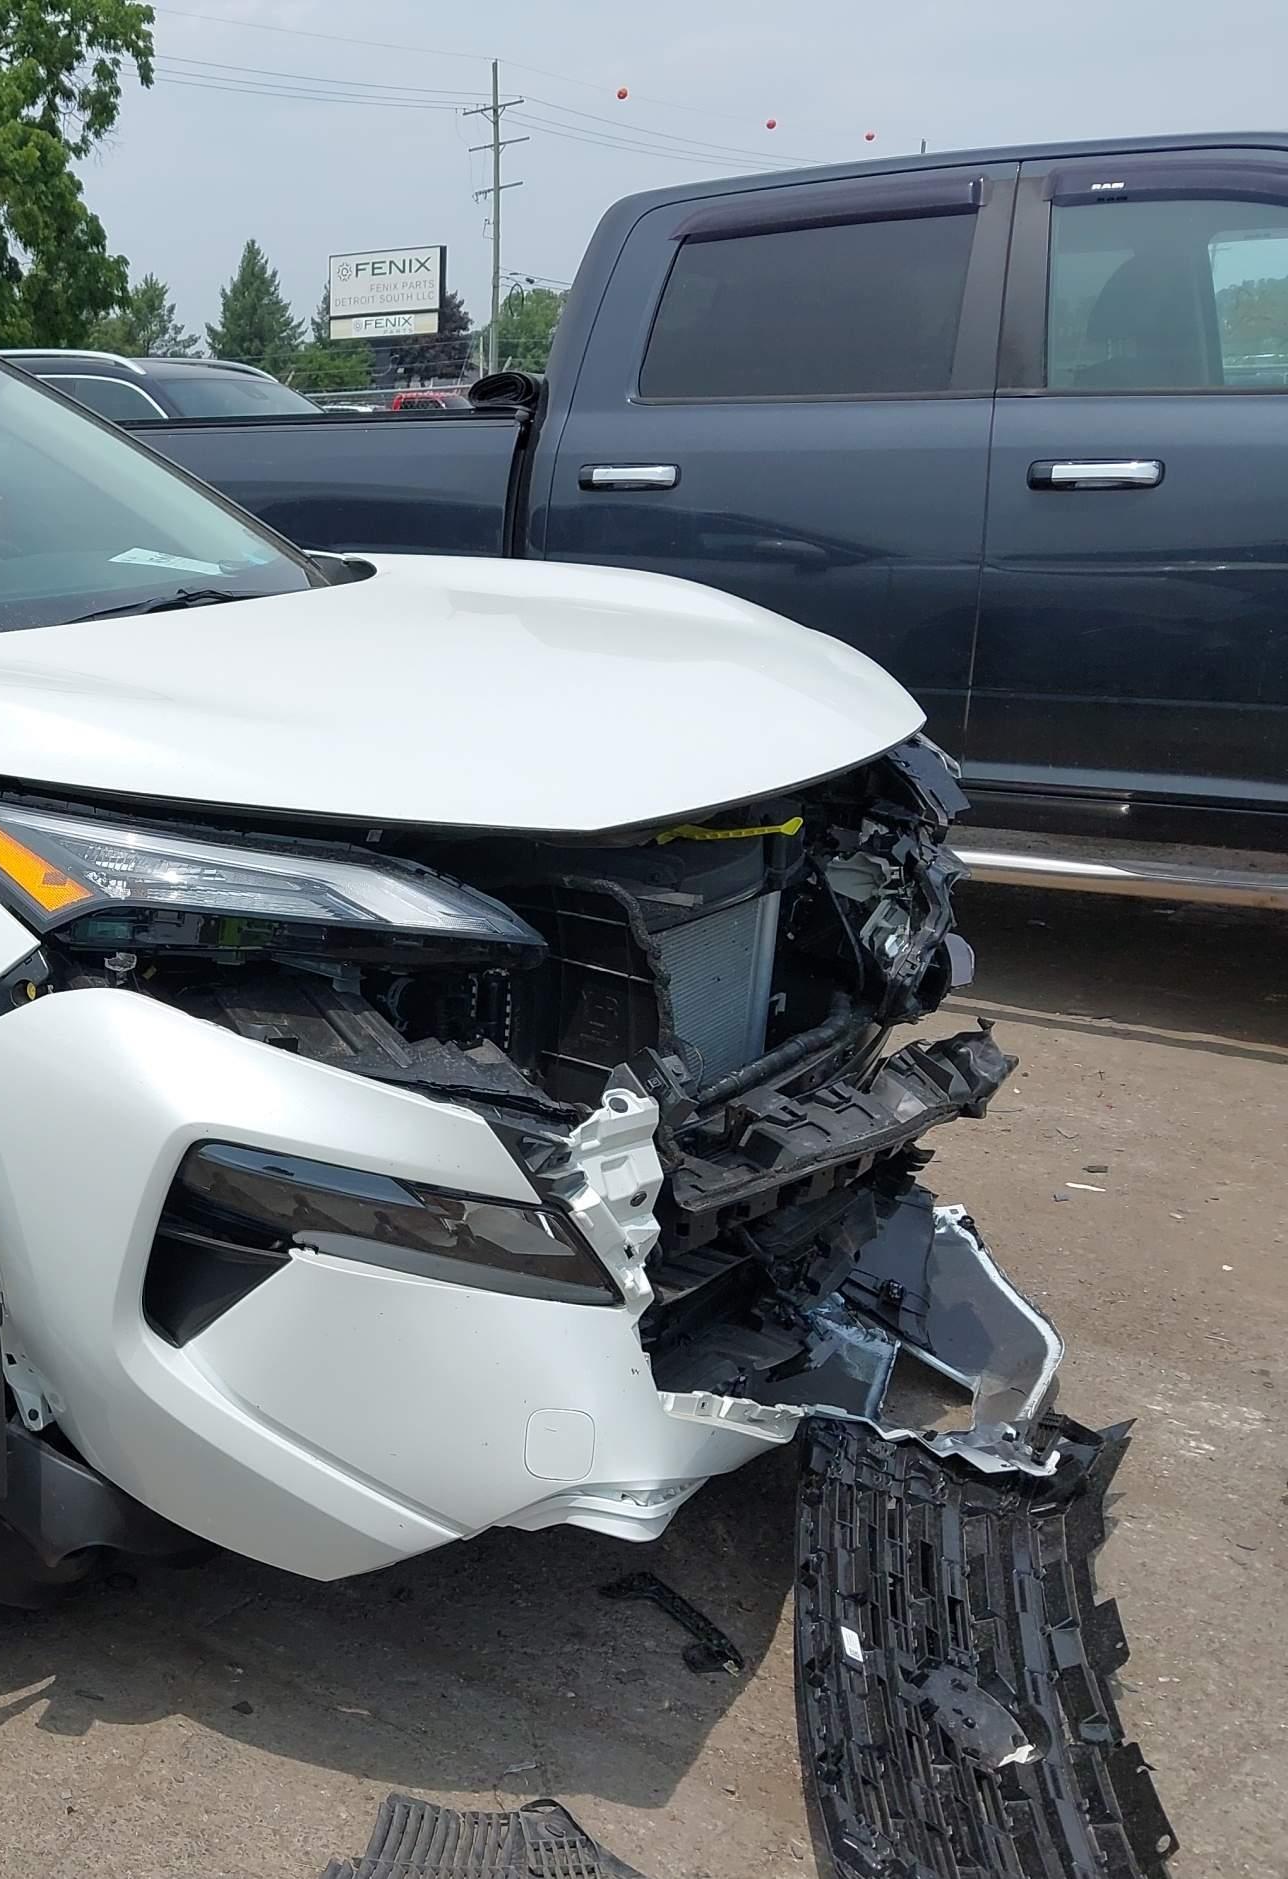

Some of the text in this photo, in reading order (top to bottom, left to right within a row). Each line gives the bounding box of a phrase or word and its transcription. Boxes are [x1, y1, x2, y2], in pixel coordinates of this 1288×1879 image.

[355, 256, 432, 278] FENIX
[369, 279, 435, 293] FENIX PARTS
[334, 290, 434, 307] DETROIT SOUTH LLC
[364, 316, 413, 329] FENIX
